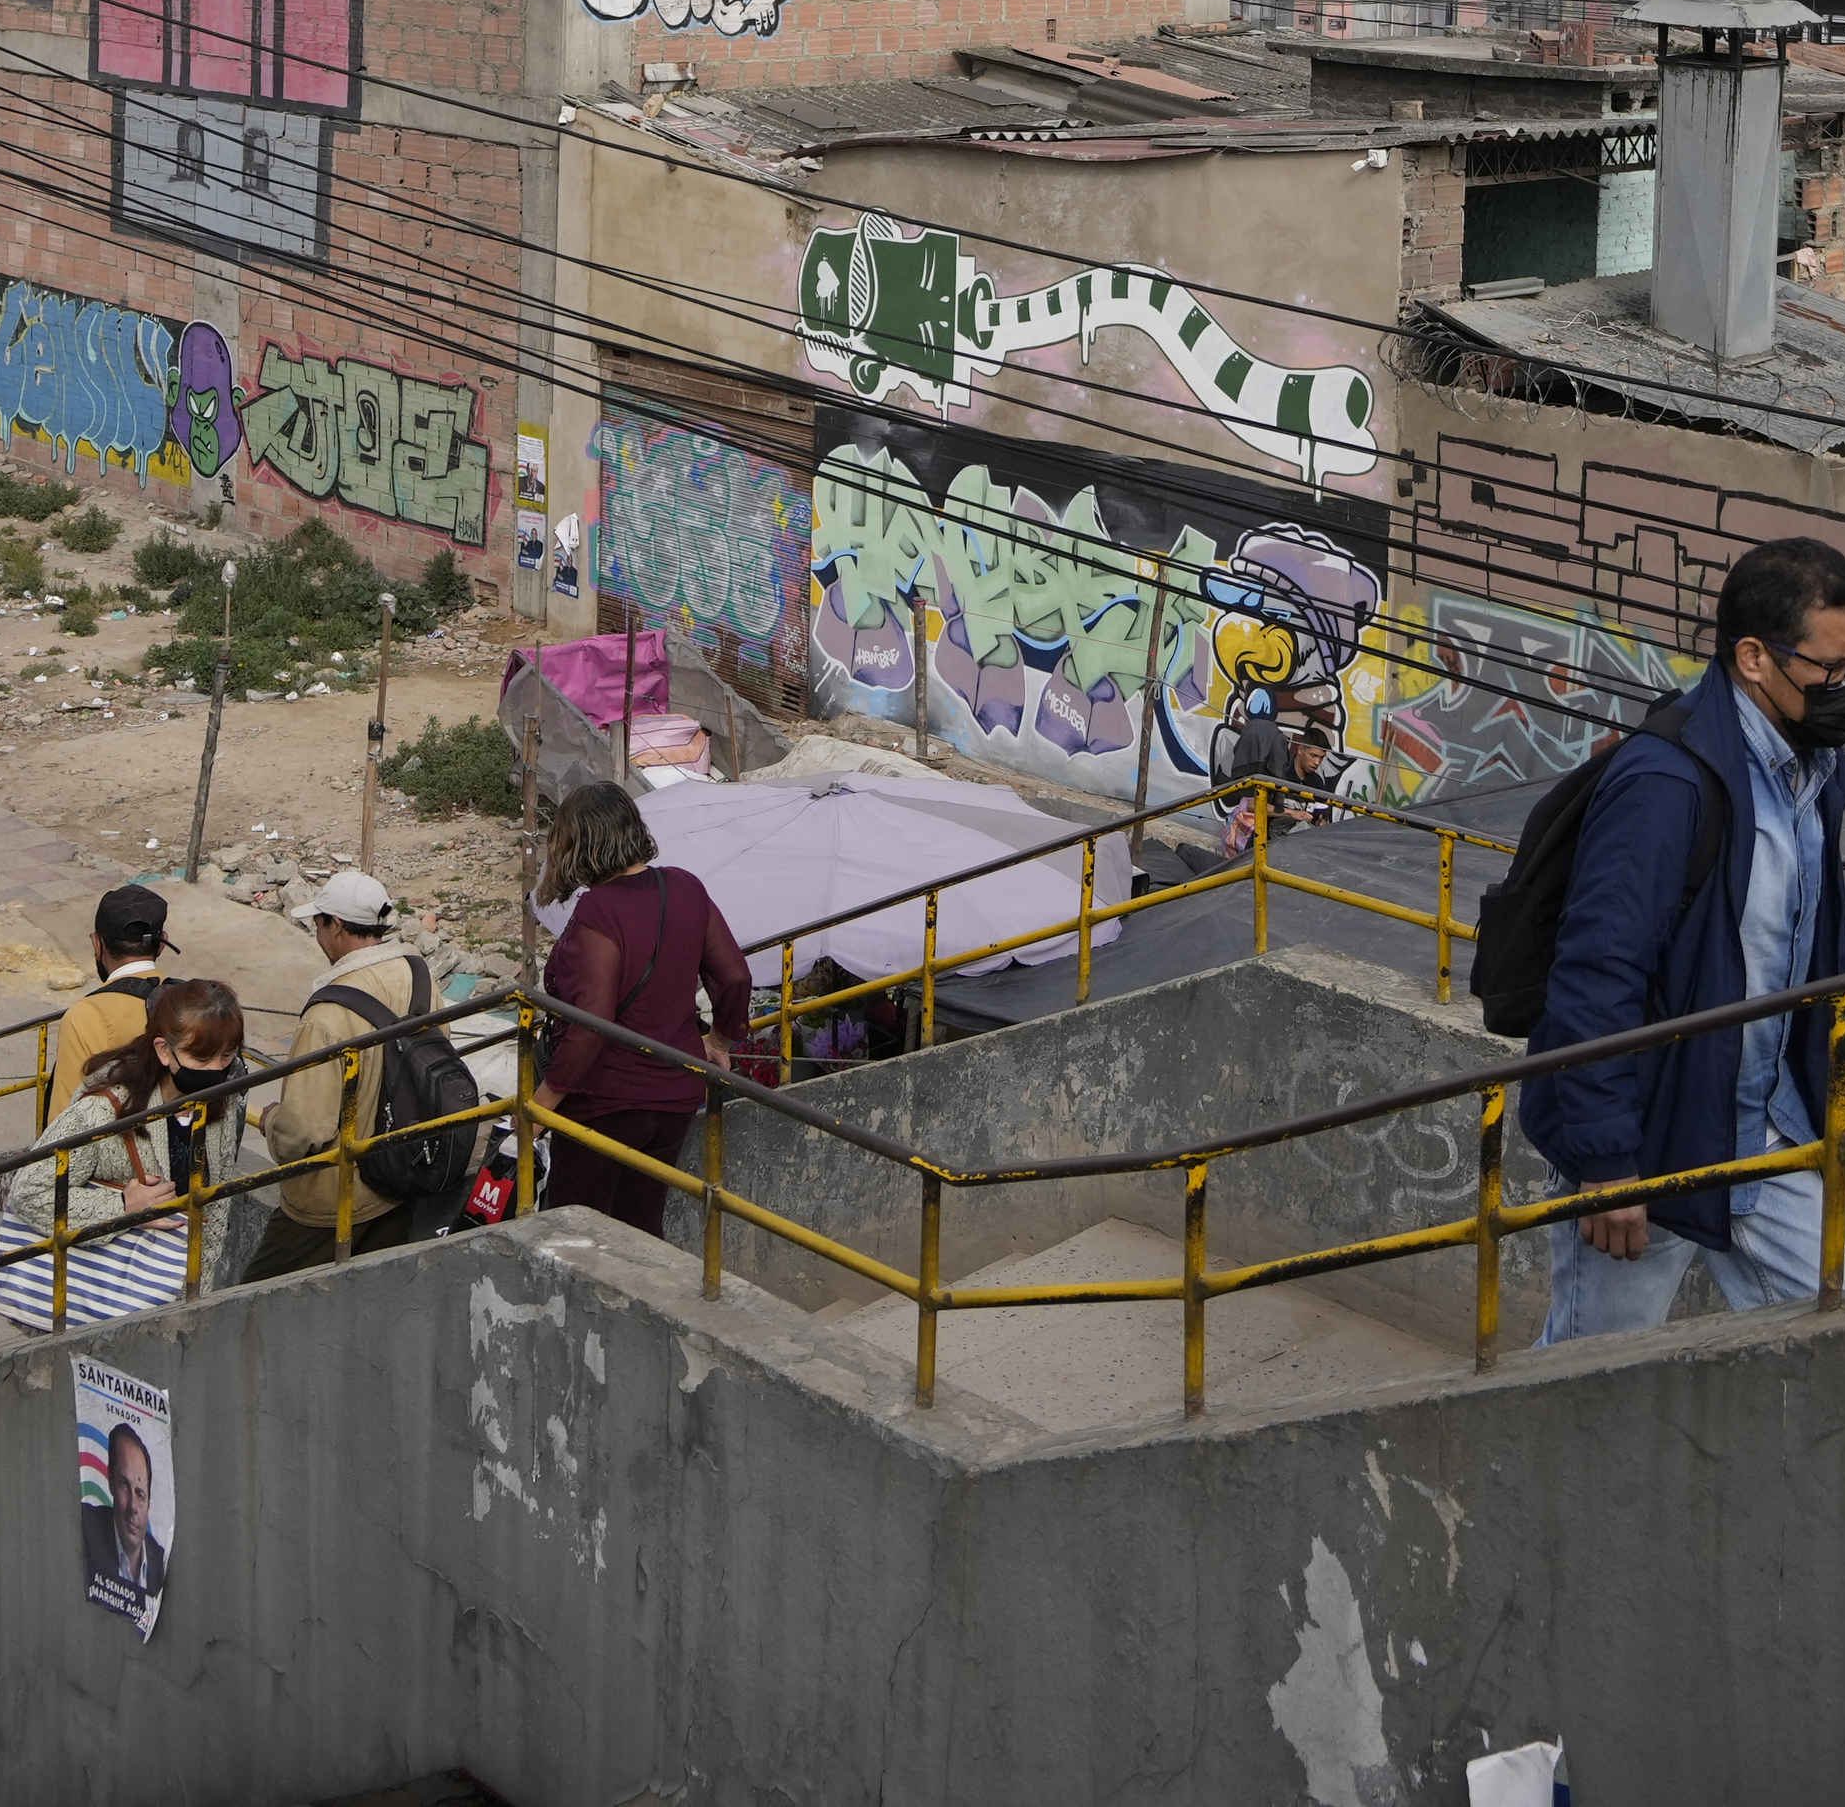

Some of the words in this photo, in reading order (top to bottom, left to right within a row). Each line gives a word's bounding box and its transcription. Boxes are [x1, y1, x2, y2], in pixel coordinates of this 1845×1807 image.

[472, 1197, 500, 1215] Movies
[478, 1181, 501, 1206] M
[78, 1363, 168, 1416] SANTAMARIA
[105, 1403, 142, 1426] SENADOR
[93, 1572, 105, 1584] AL
[105, 1578, 136, 1602] SENADO
